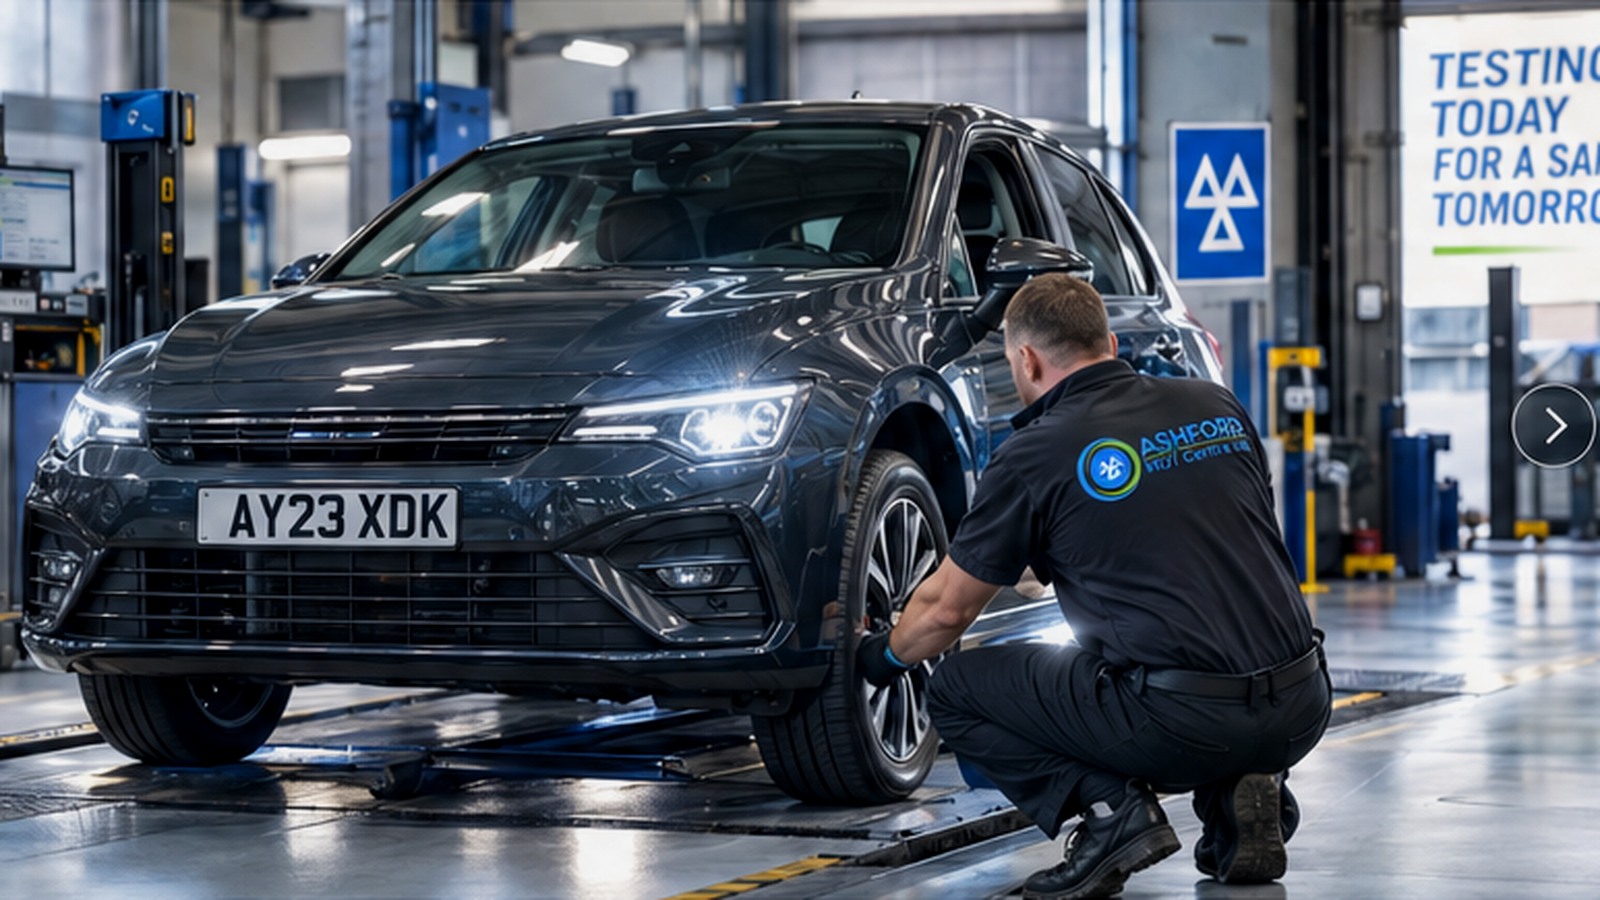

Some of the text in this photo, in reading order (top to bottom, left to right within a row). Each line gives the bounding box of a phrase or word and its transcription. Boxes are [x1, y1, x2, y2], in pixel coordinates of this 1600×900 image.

[1431, 95, 1570, 137] TODAY
[1433, 142, 1600, 181] FOR A SA
[229, 493, 448, 538] AY23 XDK
